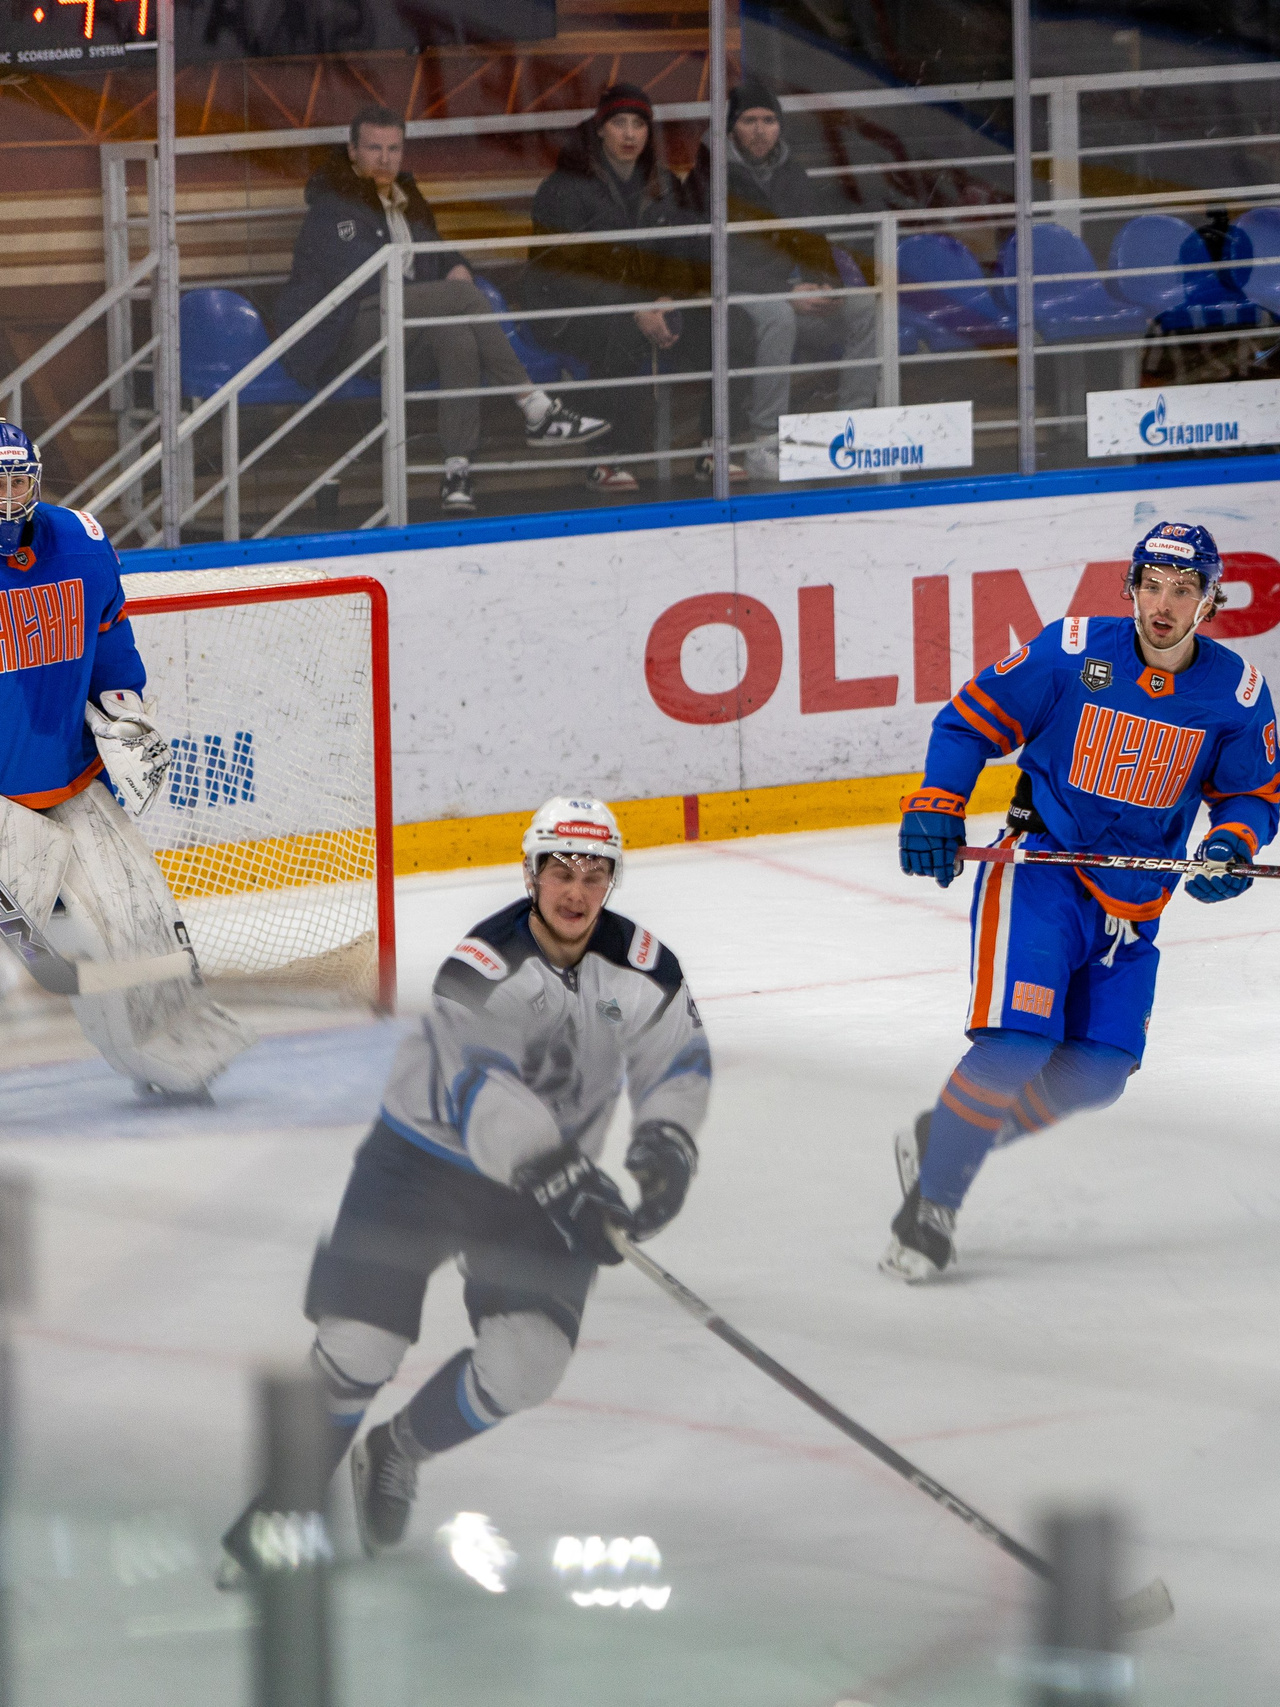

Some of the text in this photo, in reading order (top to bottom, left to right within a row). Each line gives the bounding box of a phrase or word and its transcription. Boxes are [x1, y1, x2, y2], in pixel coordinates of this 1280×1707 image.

[17, 47, 83, 63] SCOREBOARD
[88, 45, 125, 58] SYSTEM
[1168, 421, 1238, 445] ГАЗПРОМ
[857, 445, 924, 468] ГАЗПРОМ
[1149, 542, 1191, 554] OLIMPBET
[994, 646, 1030, 675] 0
[1262, 719, 1276, 765] 8
[558, 824, 608, 837] OLIMPBET
[1099, 856, 1208, 873] JETSPEE
